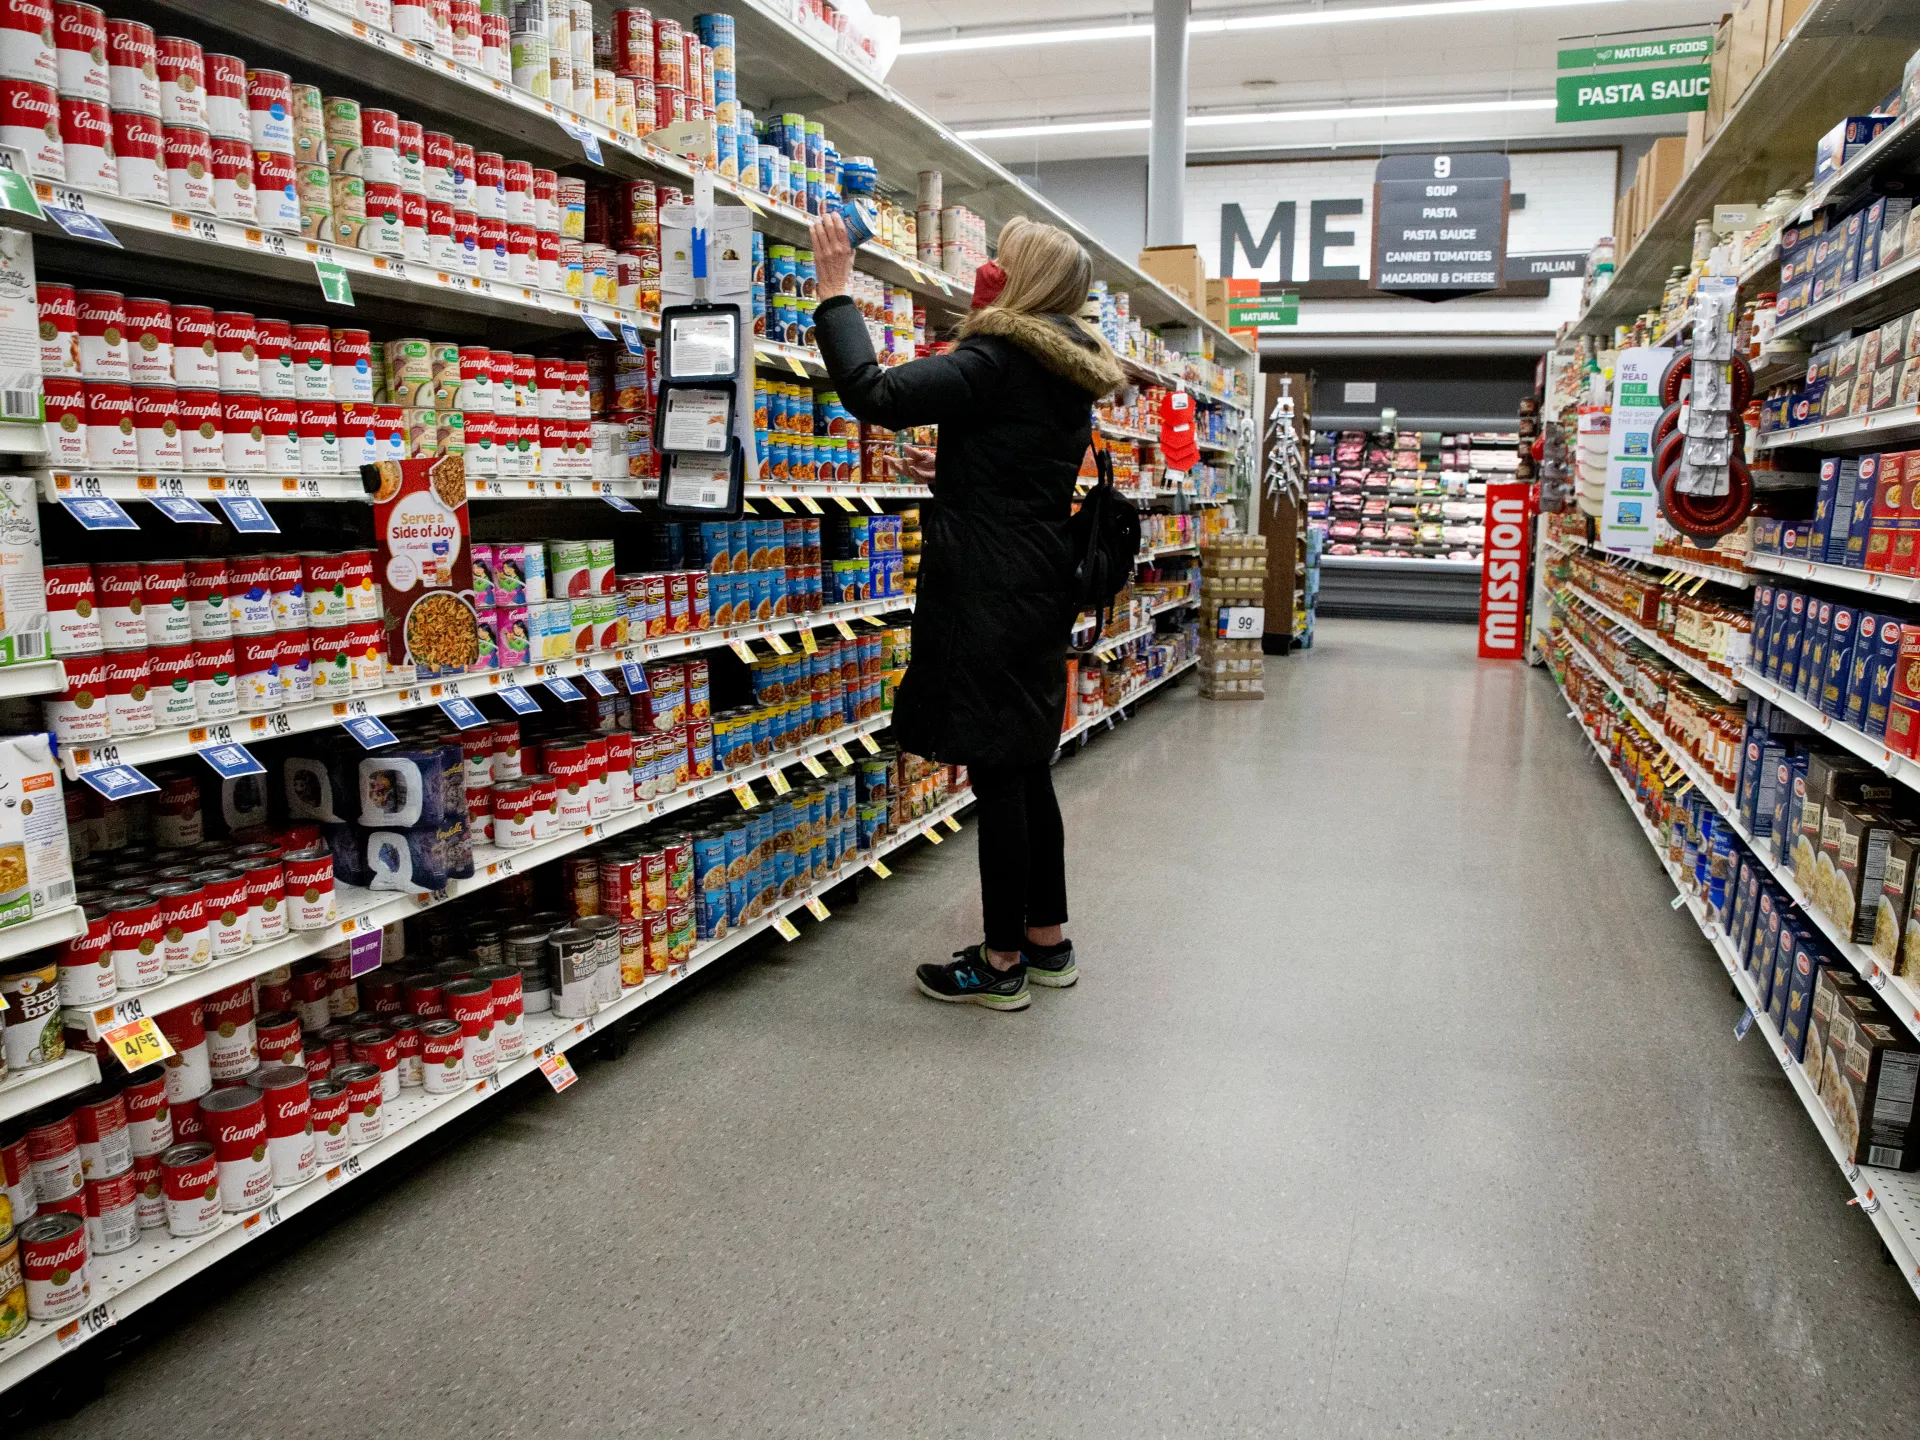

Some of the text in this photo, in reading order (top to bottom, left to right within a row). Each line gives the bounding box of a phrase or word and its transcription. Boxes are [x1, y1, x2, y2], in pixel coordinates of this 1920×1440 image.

[1614, 41, 1708, 60] NATURAL FOODS
[1578, 77, 1711, 106] PASTA SAUC
[1434, 155, 1451, 178] 9
[1425, 185, 1458, 196] SOUP
[1422, 207, 1458, 218] PASTA
[1403, 229, 1477, 241] PASTA SAUCE
[1385, 251, 1492, 263] CANNED TOMATOES
[1531, 260, 1576, 273] ITALIAN
[1381, 273, 1439, 284] MACARONI
[1451, 272, 1496, 283] CHEESE
[1240, 311, 1281, 322] NATURAL
[1621, 363, 1637, 372] WE
[1621, 372, 1648, 381] READ
[1623, 384, 1643, 393] THE
[1621, 396, 1659, 405] LABELS
[401, 513, 444, 524] Serve a
[392, 526, 455, 539] Side of Joy
[1485, 499, 1524, 649] mission
[561, 806, 587, 814] Tomato
[302, 906, 325, 914] Chicken
[260, 915, 282, 923] Chicken
[303, 912, 324, 920] Noodle
[262, 921, 282, 929] Noodle
[219, 929, 242, 938] Chicken
[220, 936, 241, 945] Noodle
[165, 946, 189, 954] Chicken
[165, 953, 189, 961] Noodle
[136, 958, 160, 968] Chicken
[138, 965, 160, 975] Noodle
[499, 1036, 517, 1045] Cream
[501, 1041, 522, 1051] Chicken
[213, 1051, 235, 1061] Cream
[473, 1053, 489, 1062] Cream
[211, 1056, 251, 1068] Mushroom
[475, 1058, 496, 1068] Chicken
[220, 1068, 243, 1077] SOUP
[479, 1066, 494, 1075] SOUP
[324, 1139, 340, 1147] Cream
[327, 1143, 346, 1152] Chicken
[46, 1287, 68, 1299] Cream
[44, 1292, 81, 1306] Mushroom
[54, 1304, 75, 1315] SOUP
